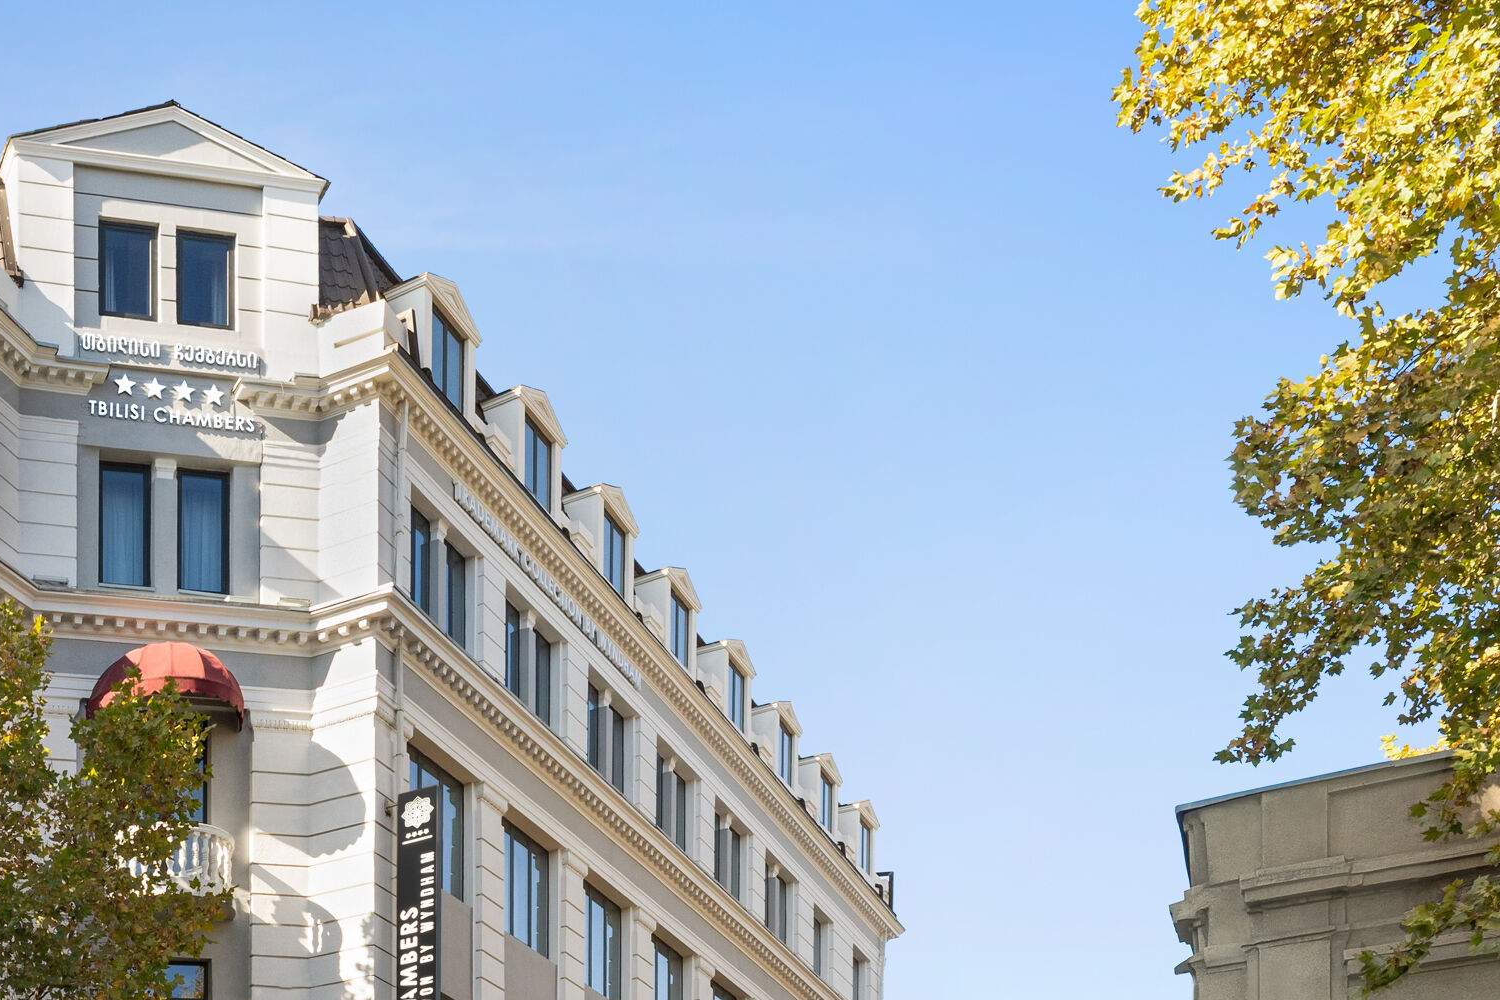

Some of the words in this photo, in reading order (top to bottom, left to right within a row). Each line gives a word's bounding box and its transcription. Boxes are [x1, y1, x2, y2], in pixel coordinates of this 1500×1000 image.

[88, 400, 145, 421] TBILISI
[154, 406, 256, 433] CHAMBERS
[453, 479, 521, 562] TRADEMARK
[521, 552, 583, 629] COLLECTION
[583, 616, 598, 642] BY
[598, 632, 642, 689] WYNDHAM
[420, 851, 436, 934] WYNDHAM
[419, 945, 434, 964] BY
